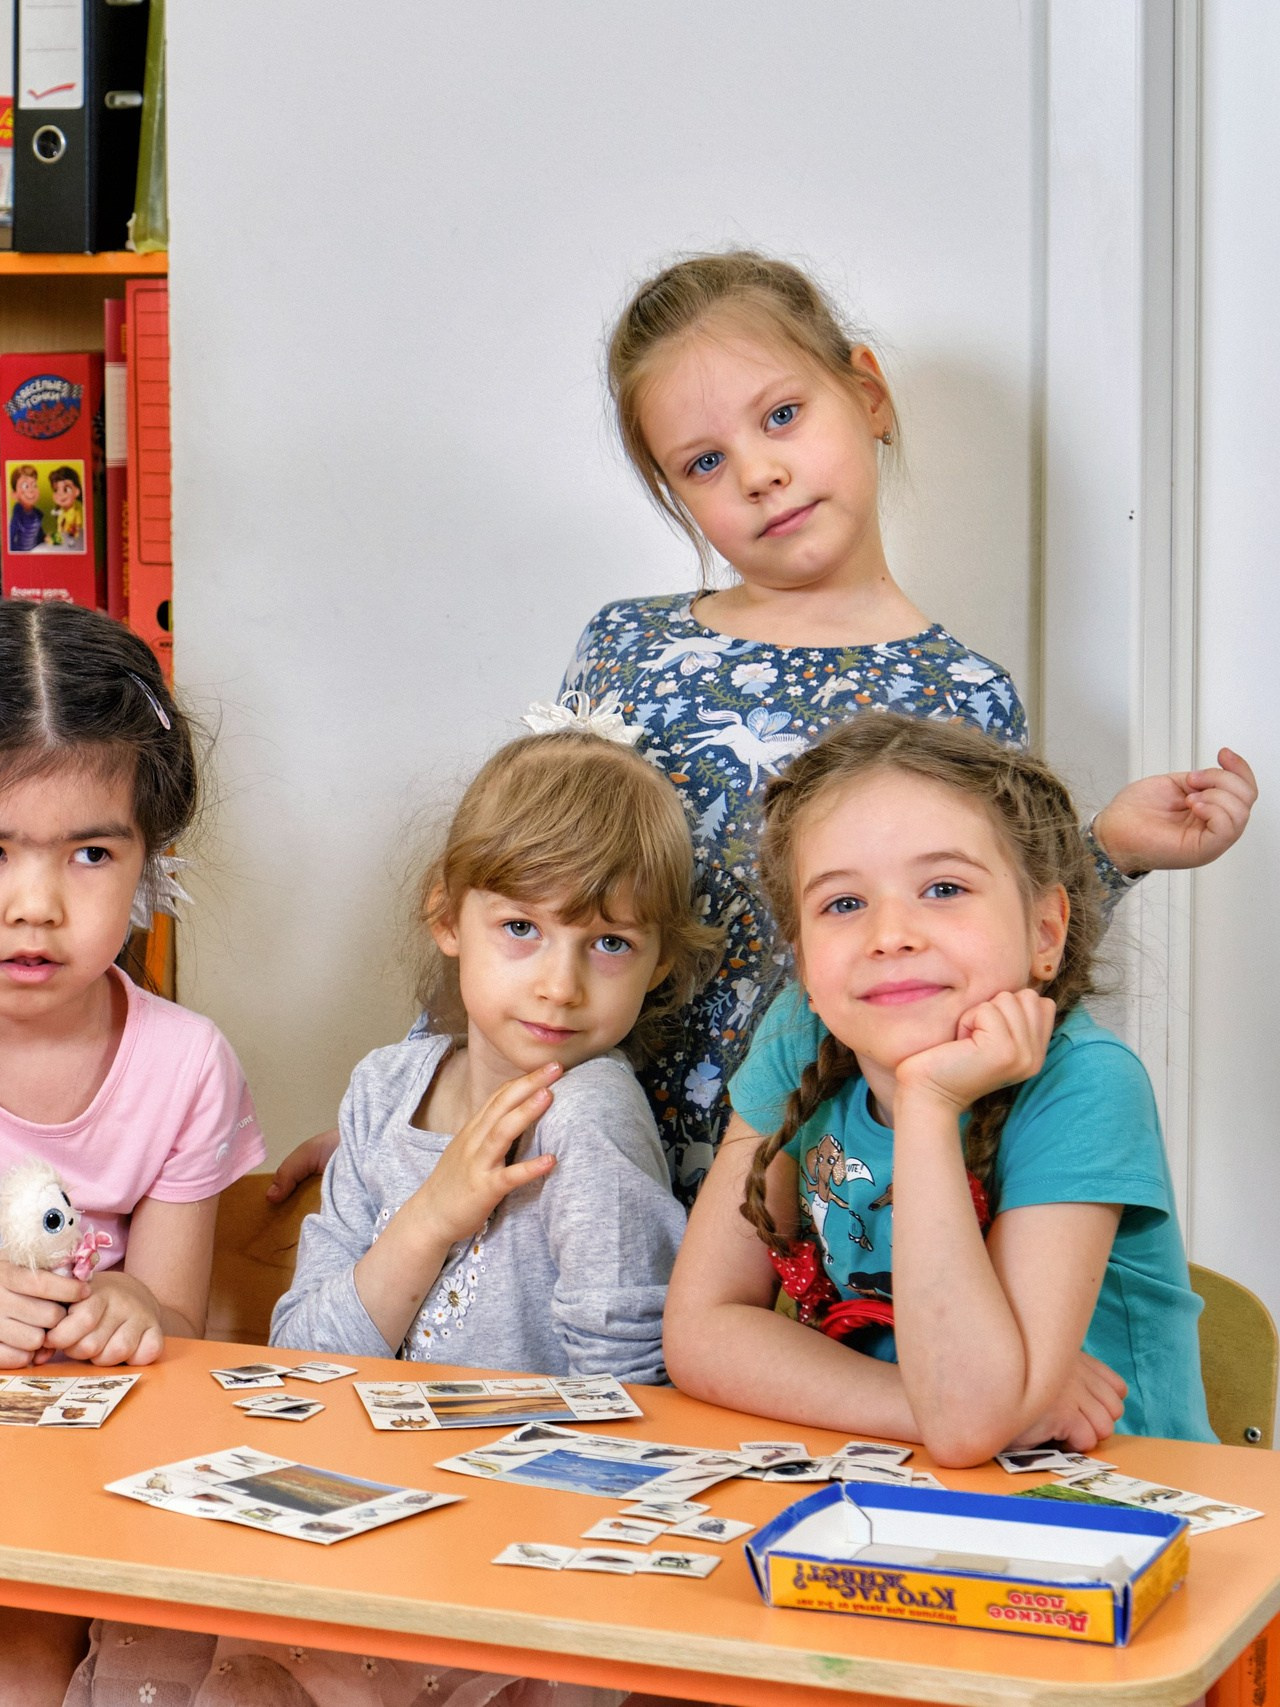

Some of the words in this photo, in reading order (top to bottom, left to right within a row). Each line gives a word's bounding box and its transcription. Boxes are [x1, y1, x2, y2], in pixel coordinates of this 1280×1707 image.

[896, 1585, 957, 1611] Кто
[1008, 1590, 1067, 1610] лото
[886, 1605, 907, 1617] для
[988, 1604, 1088, 1633] Детское
